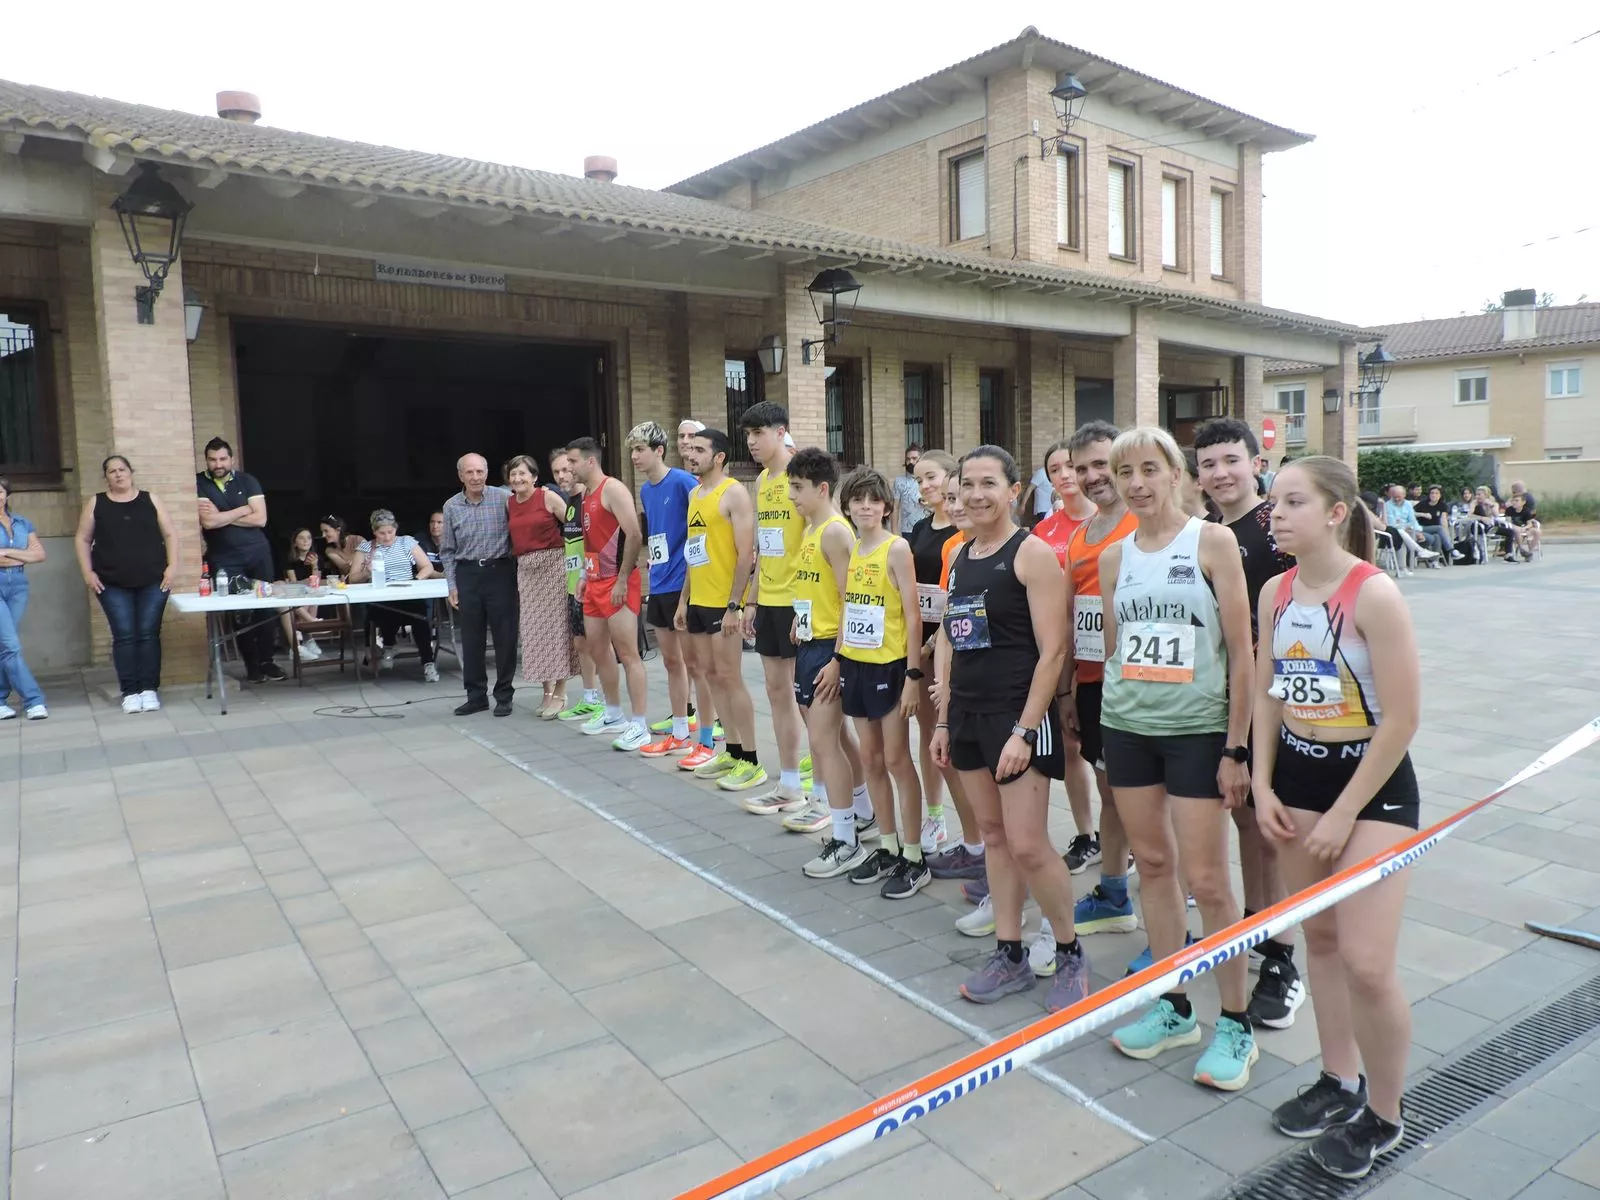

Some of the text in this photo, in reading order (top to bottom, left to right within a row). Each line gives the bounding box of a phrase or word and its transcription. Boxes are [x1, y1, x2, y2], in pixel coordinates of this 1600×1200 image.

[688, 544, 701, 556] 906
[847, 620, 875, 635] 1024
[950, 618, 973, 638] 619
[1126, 635, 1184, 666] 241
[1279, 676, 1326, 704] 385
[1286, 732, 1329, 759] PRO
